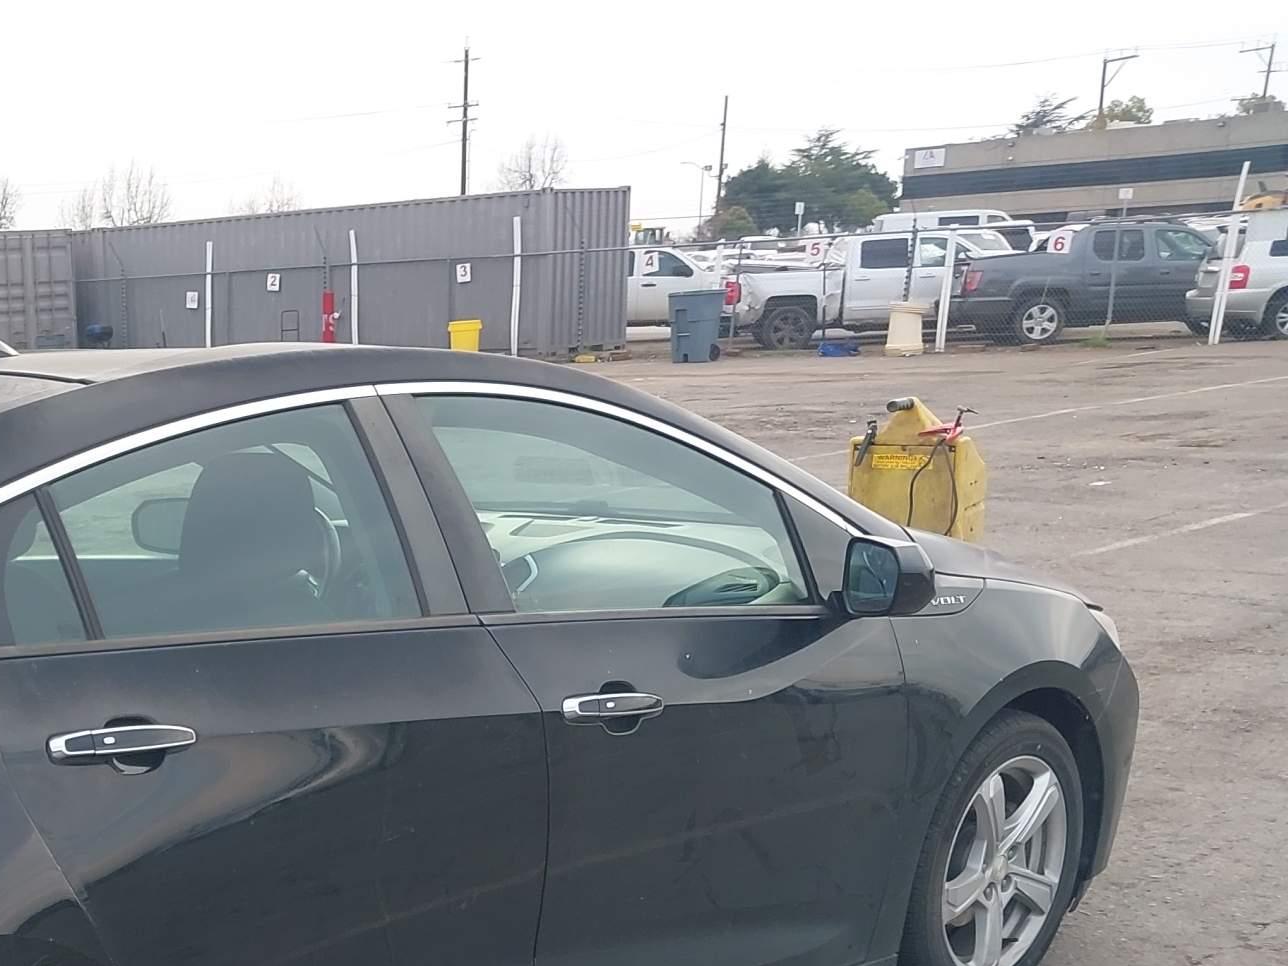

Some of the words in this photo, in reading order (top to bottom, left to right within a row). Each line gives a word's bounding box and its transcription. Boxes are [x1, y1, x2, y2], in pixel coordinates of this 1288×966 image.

[810, 242, 820, 256] 5
[1054, 236, 1066, 251] 6
[645, 255, 654, 267] 4
[459, 265, 468, 278] 3
[270, 275, 278, 287] 2
[931, 595, 966, 606] VOLT
